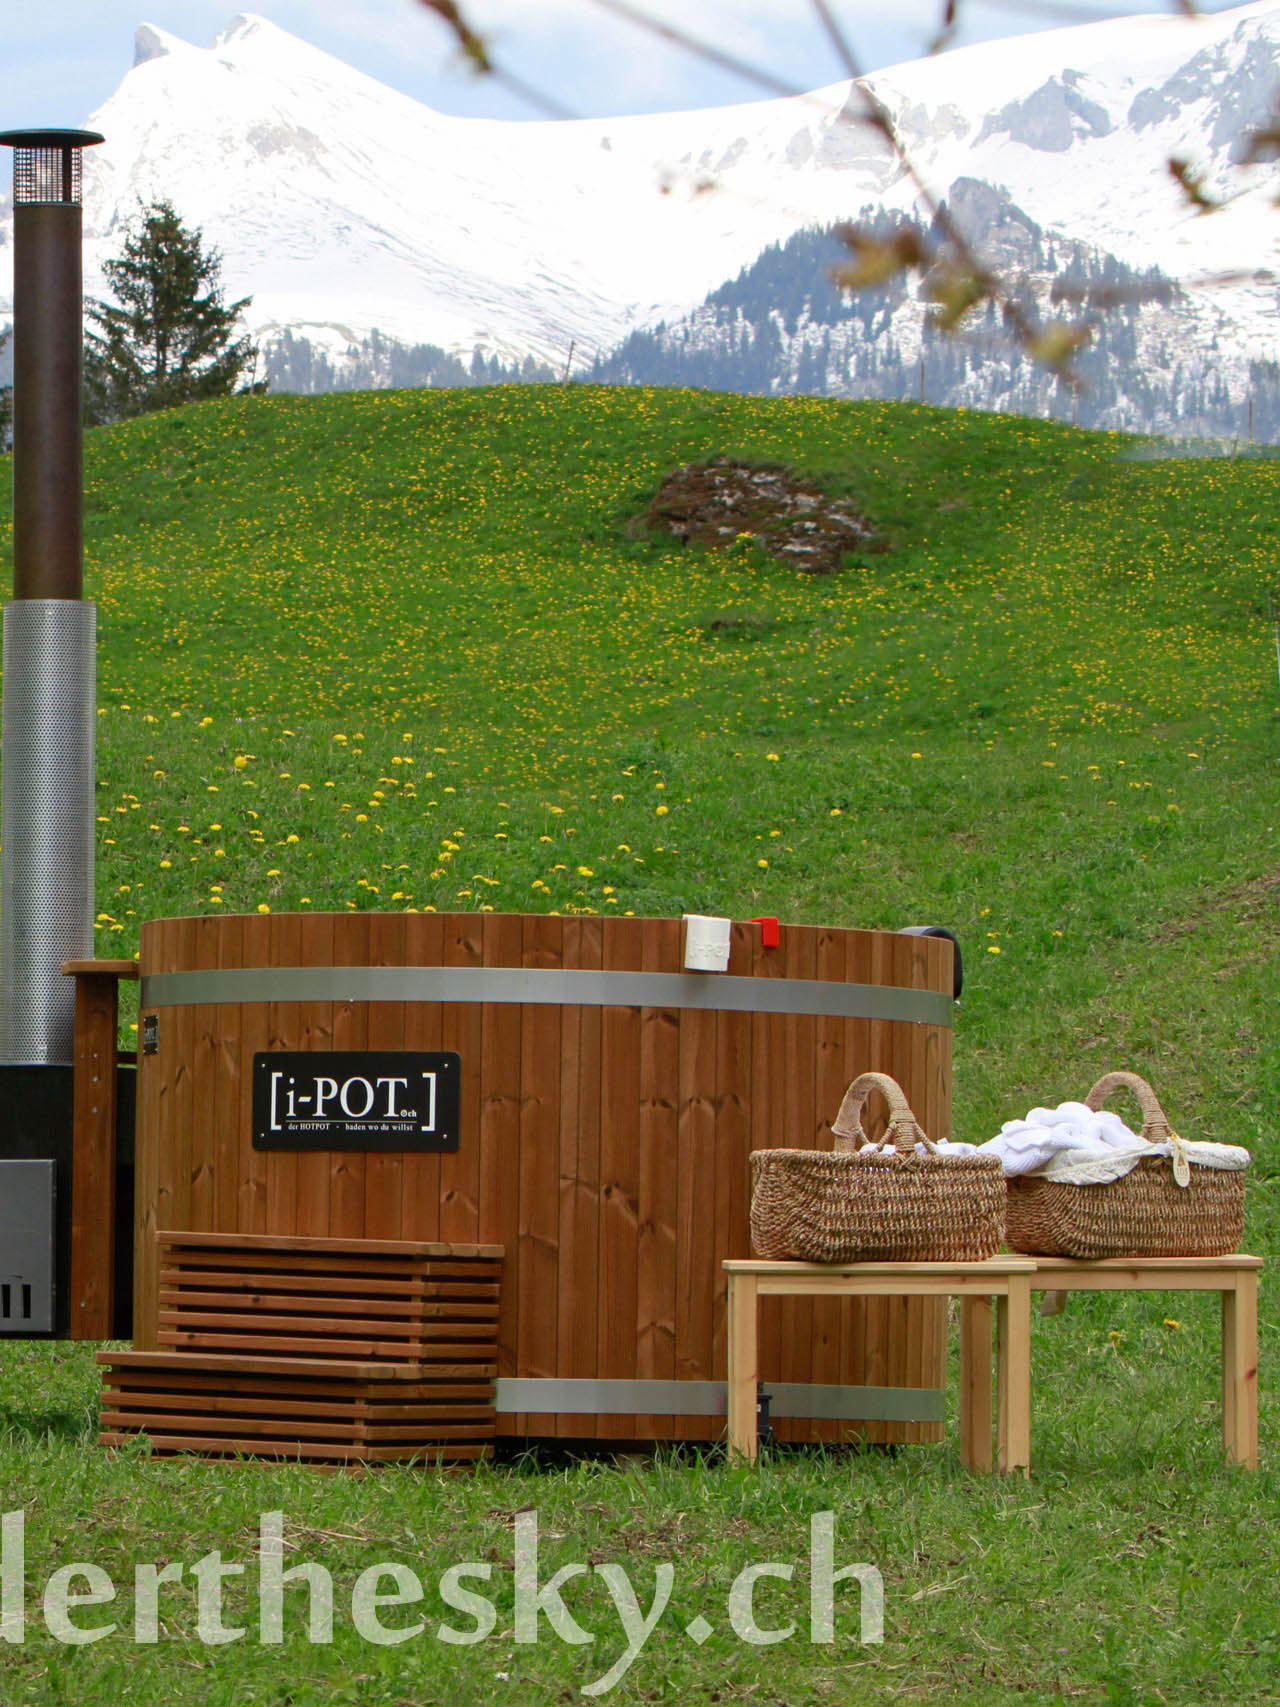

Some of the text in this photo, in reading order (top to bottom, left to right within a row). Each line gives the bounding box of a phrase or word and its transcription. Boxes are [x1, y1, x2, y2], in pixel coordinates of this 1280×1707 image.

[288, 1123, 299, 1131] der
[300, 1123, 330, 1131] HOTPOT
[345, 1123, 366, 1131] baden
